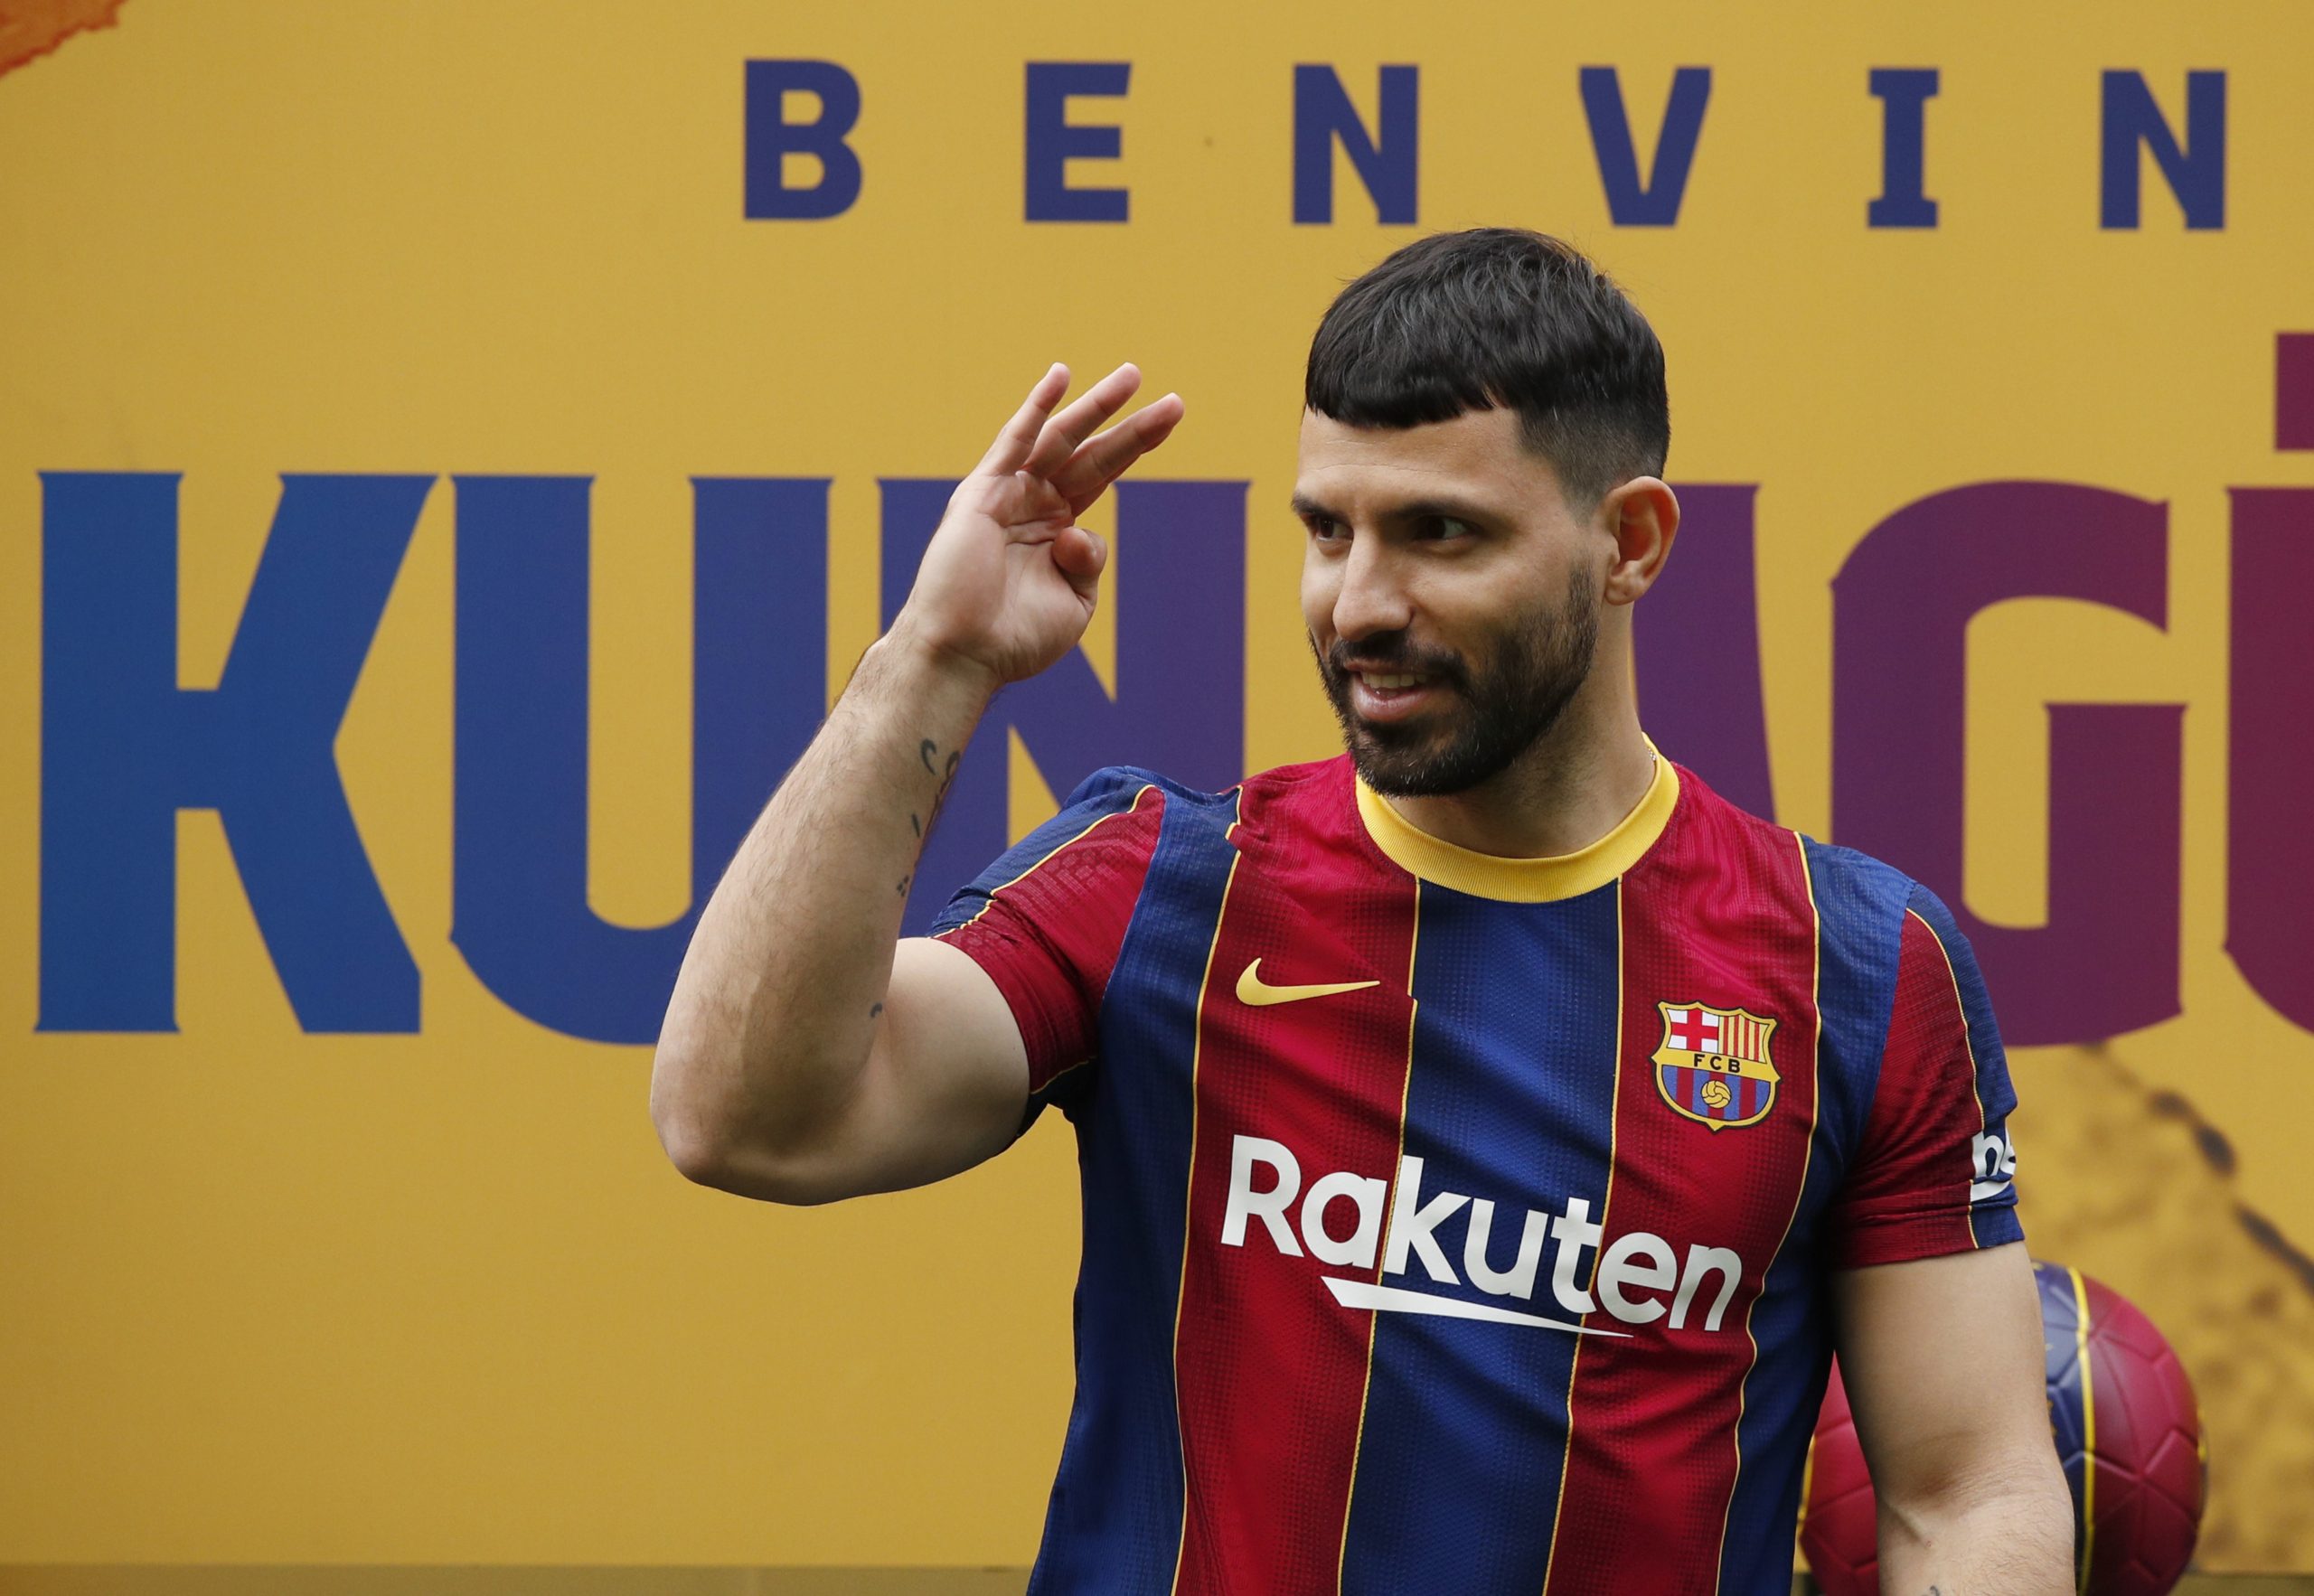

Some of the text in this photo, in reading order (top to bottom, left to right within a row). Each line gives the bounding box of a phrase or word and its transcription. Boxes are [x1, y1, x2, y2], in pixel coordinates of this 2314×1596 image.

[743, 59, 2225, 230] BENVIN
[1693, 1053, 1741, 1074] FCB
[1220, 1134, 1744, 1333] Rakuten
